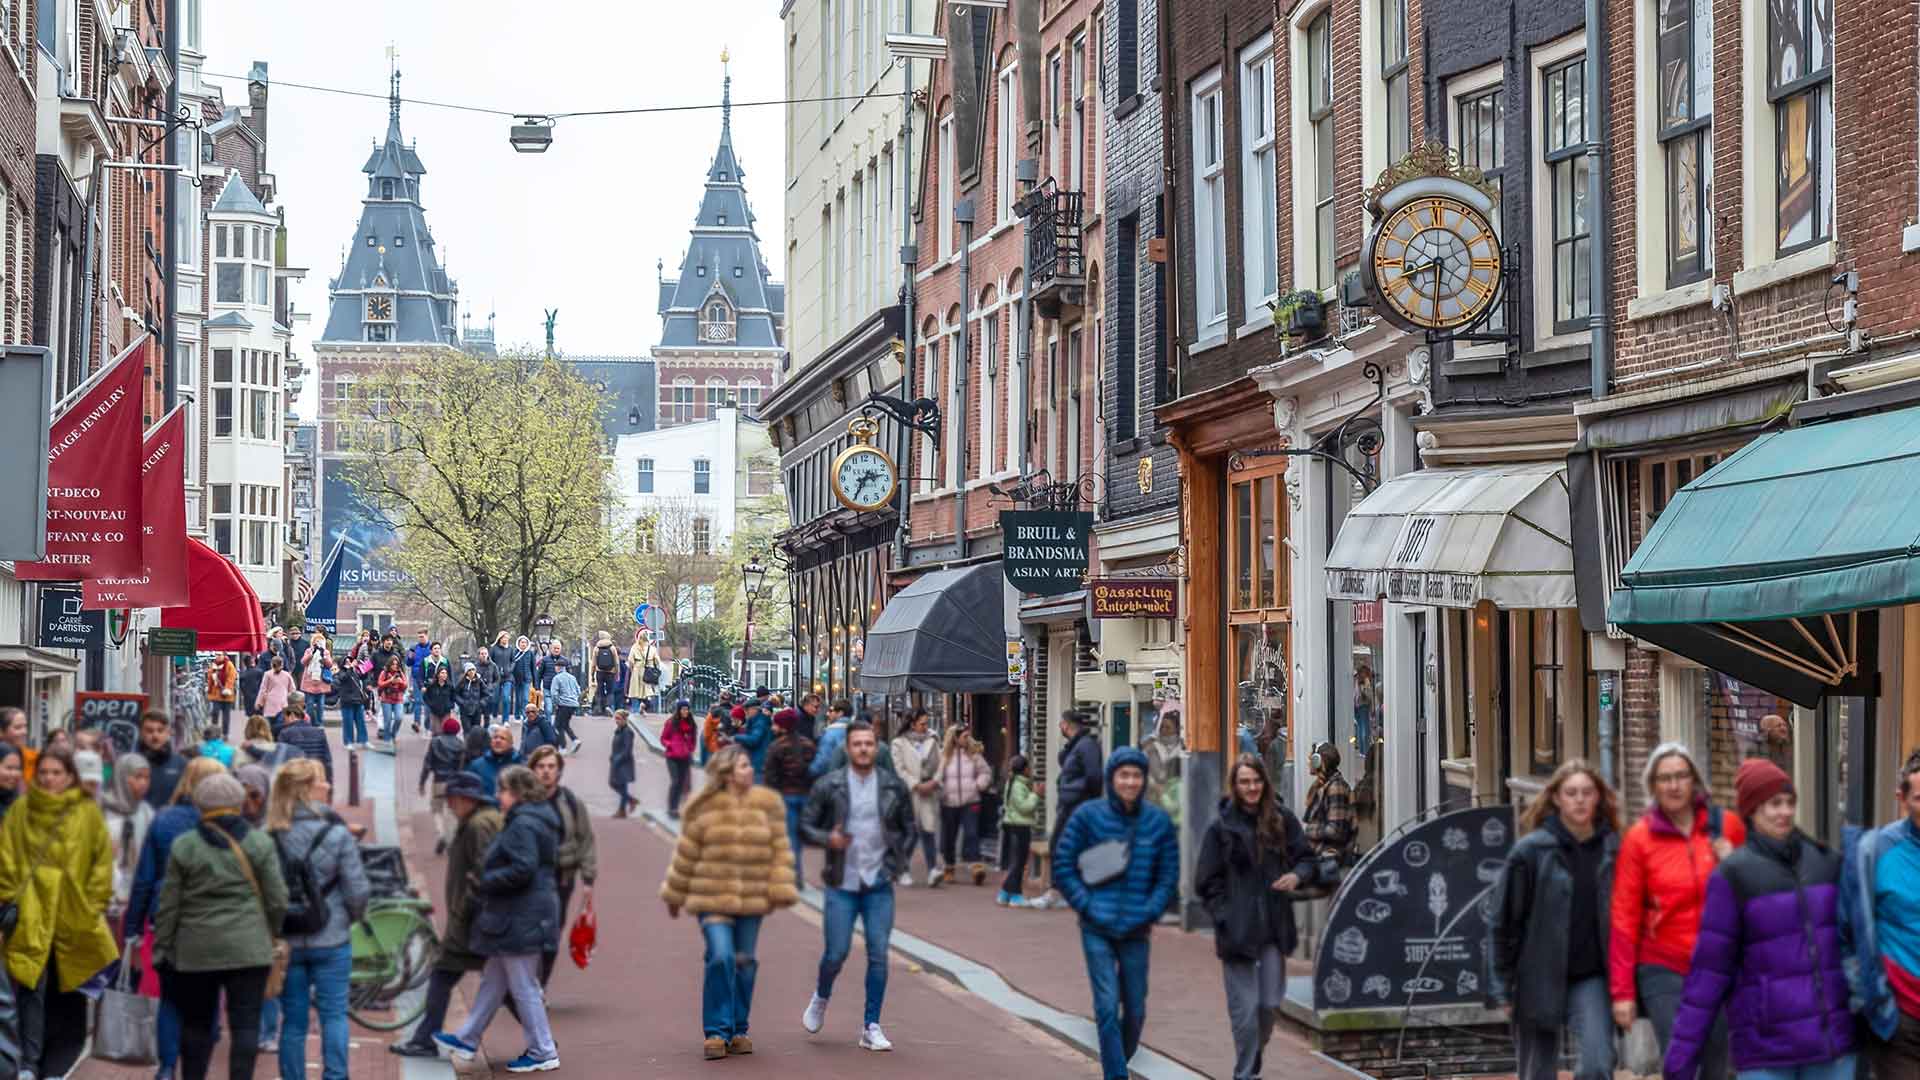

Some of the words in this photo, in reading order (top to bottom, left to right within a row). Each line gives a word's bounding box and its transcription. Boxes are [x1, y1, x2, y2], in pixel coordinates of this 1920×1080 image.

[47, 429, 82, 464] NTAGE
[79, 385, 126, 432] JEWELRY
[843, 464, 851, 472] 10
[47, 488, 100, 498] RT-DECO
[46, 510, 127, 520] RT-NOUVEAU
[47, 532, 88, 542] FFANY
[91, 532, 101, 542] &
[104, 532, 124, 542] CO
[1017, 526, 1060, 540] BRUIL
[1065, 527, 1076, 540] &
[1008, 547, 1086, 560] BRANDSMA
[40, 554, 91, 564] ARTIER
[1013, 567, 1050, 577] ASIAN
[63, 637, 86, 645] Gallery
